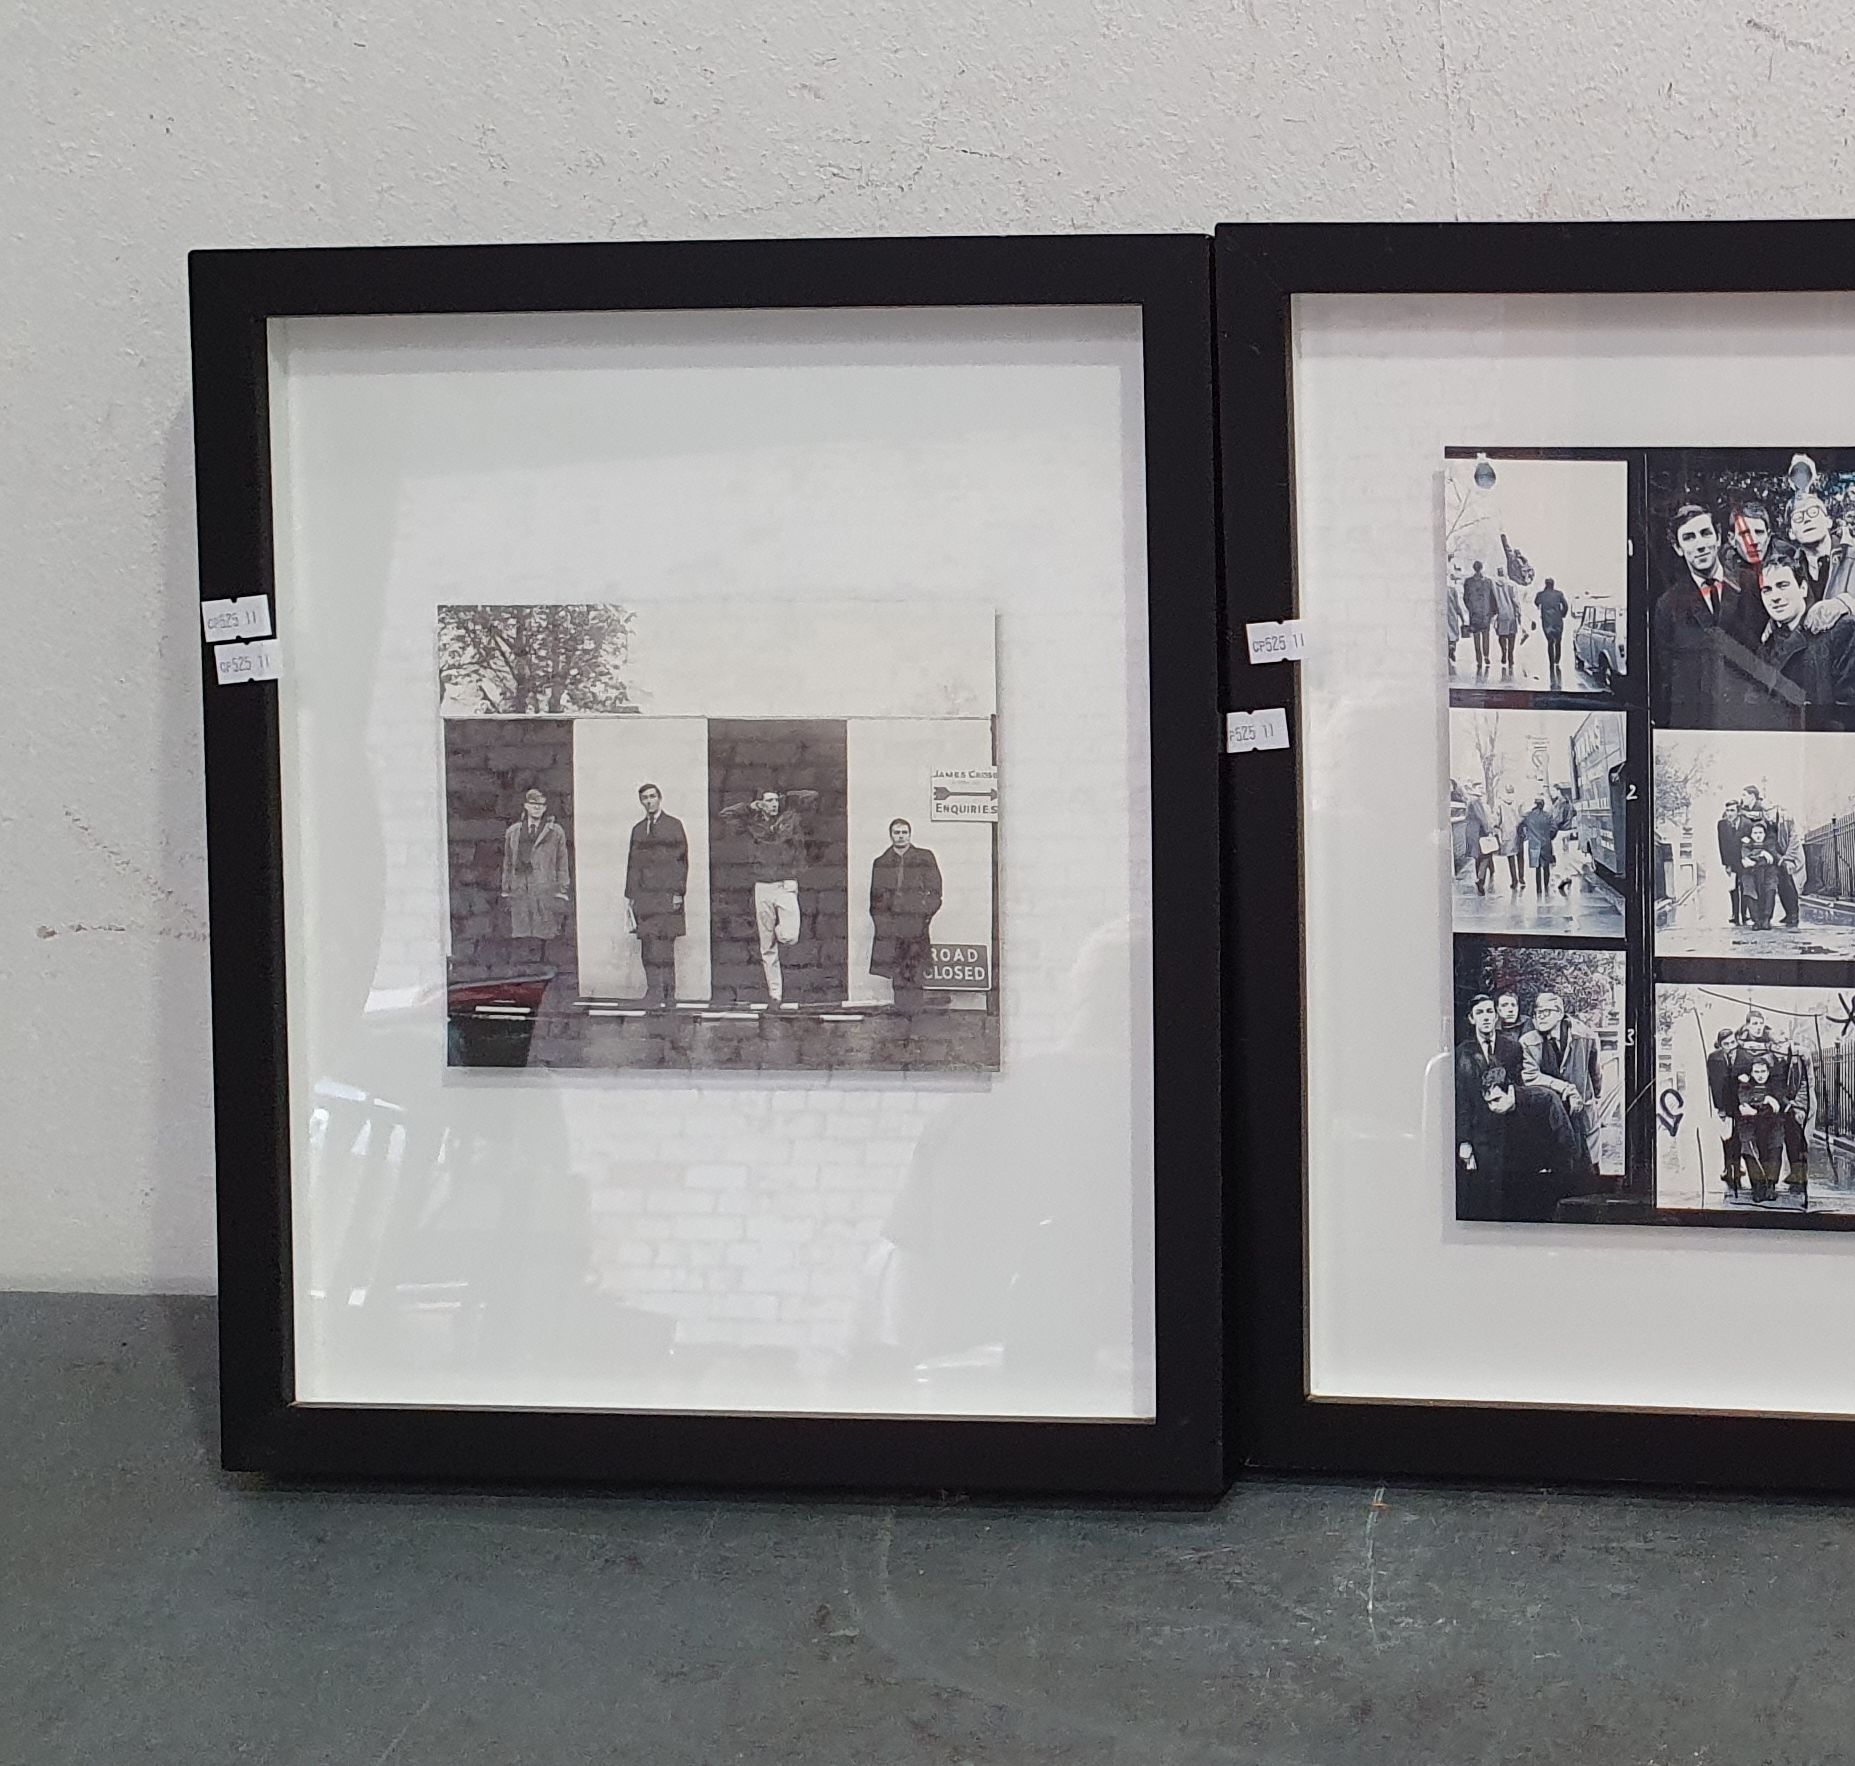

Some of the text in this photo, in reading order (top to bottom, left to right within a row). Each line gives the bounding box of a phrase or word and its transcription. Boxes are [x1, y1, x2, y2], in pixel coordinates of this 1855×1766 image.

[1626, 784, 1638, 801] 2
[935, 802, 999, 816] ENQUIRIES
[922, 965, 986, 981] CLOSED
